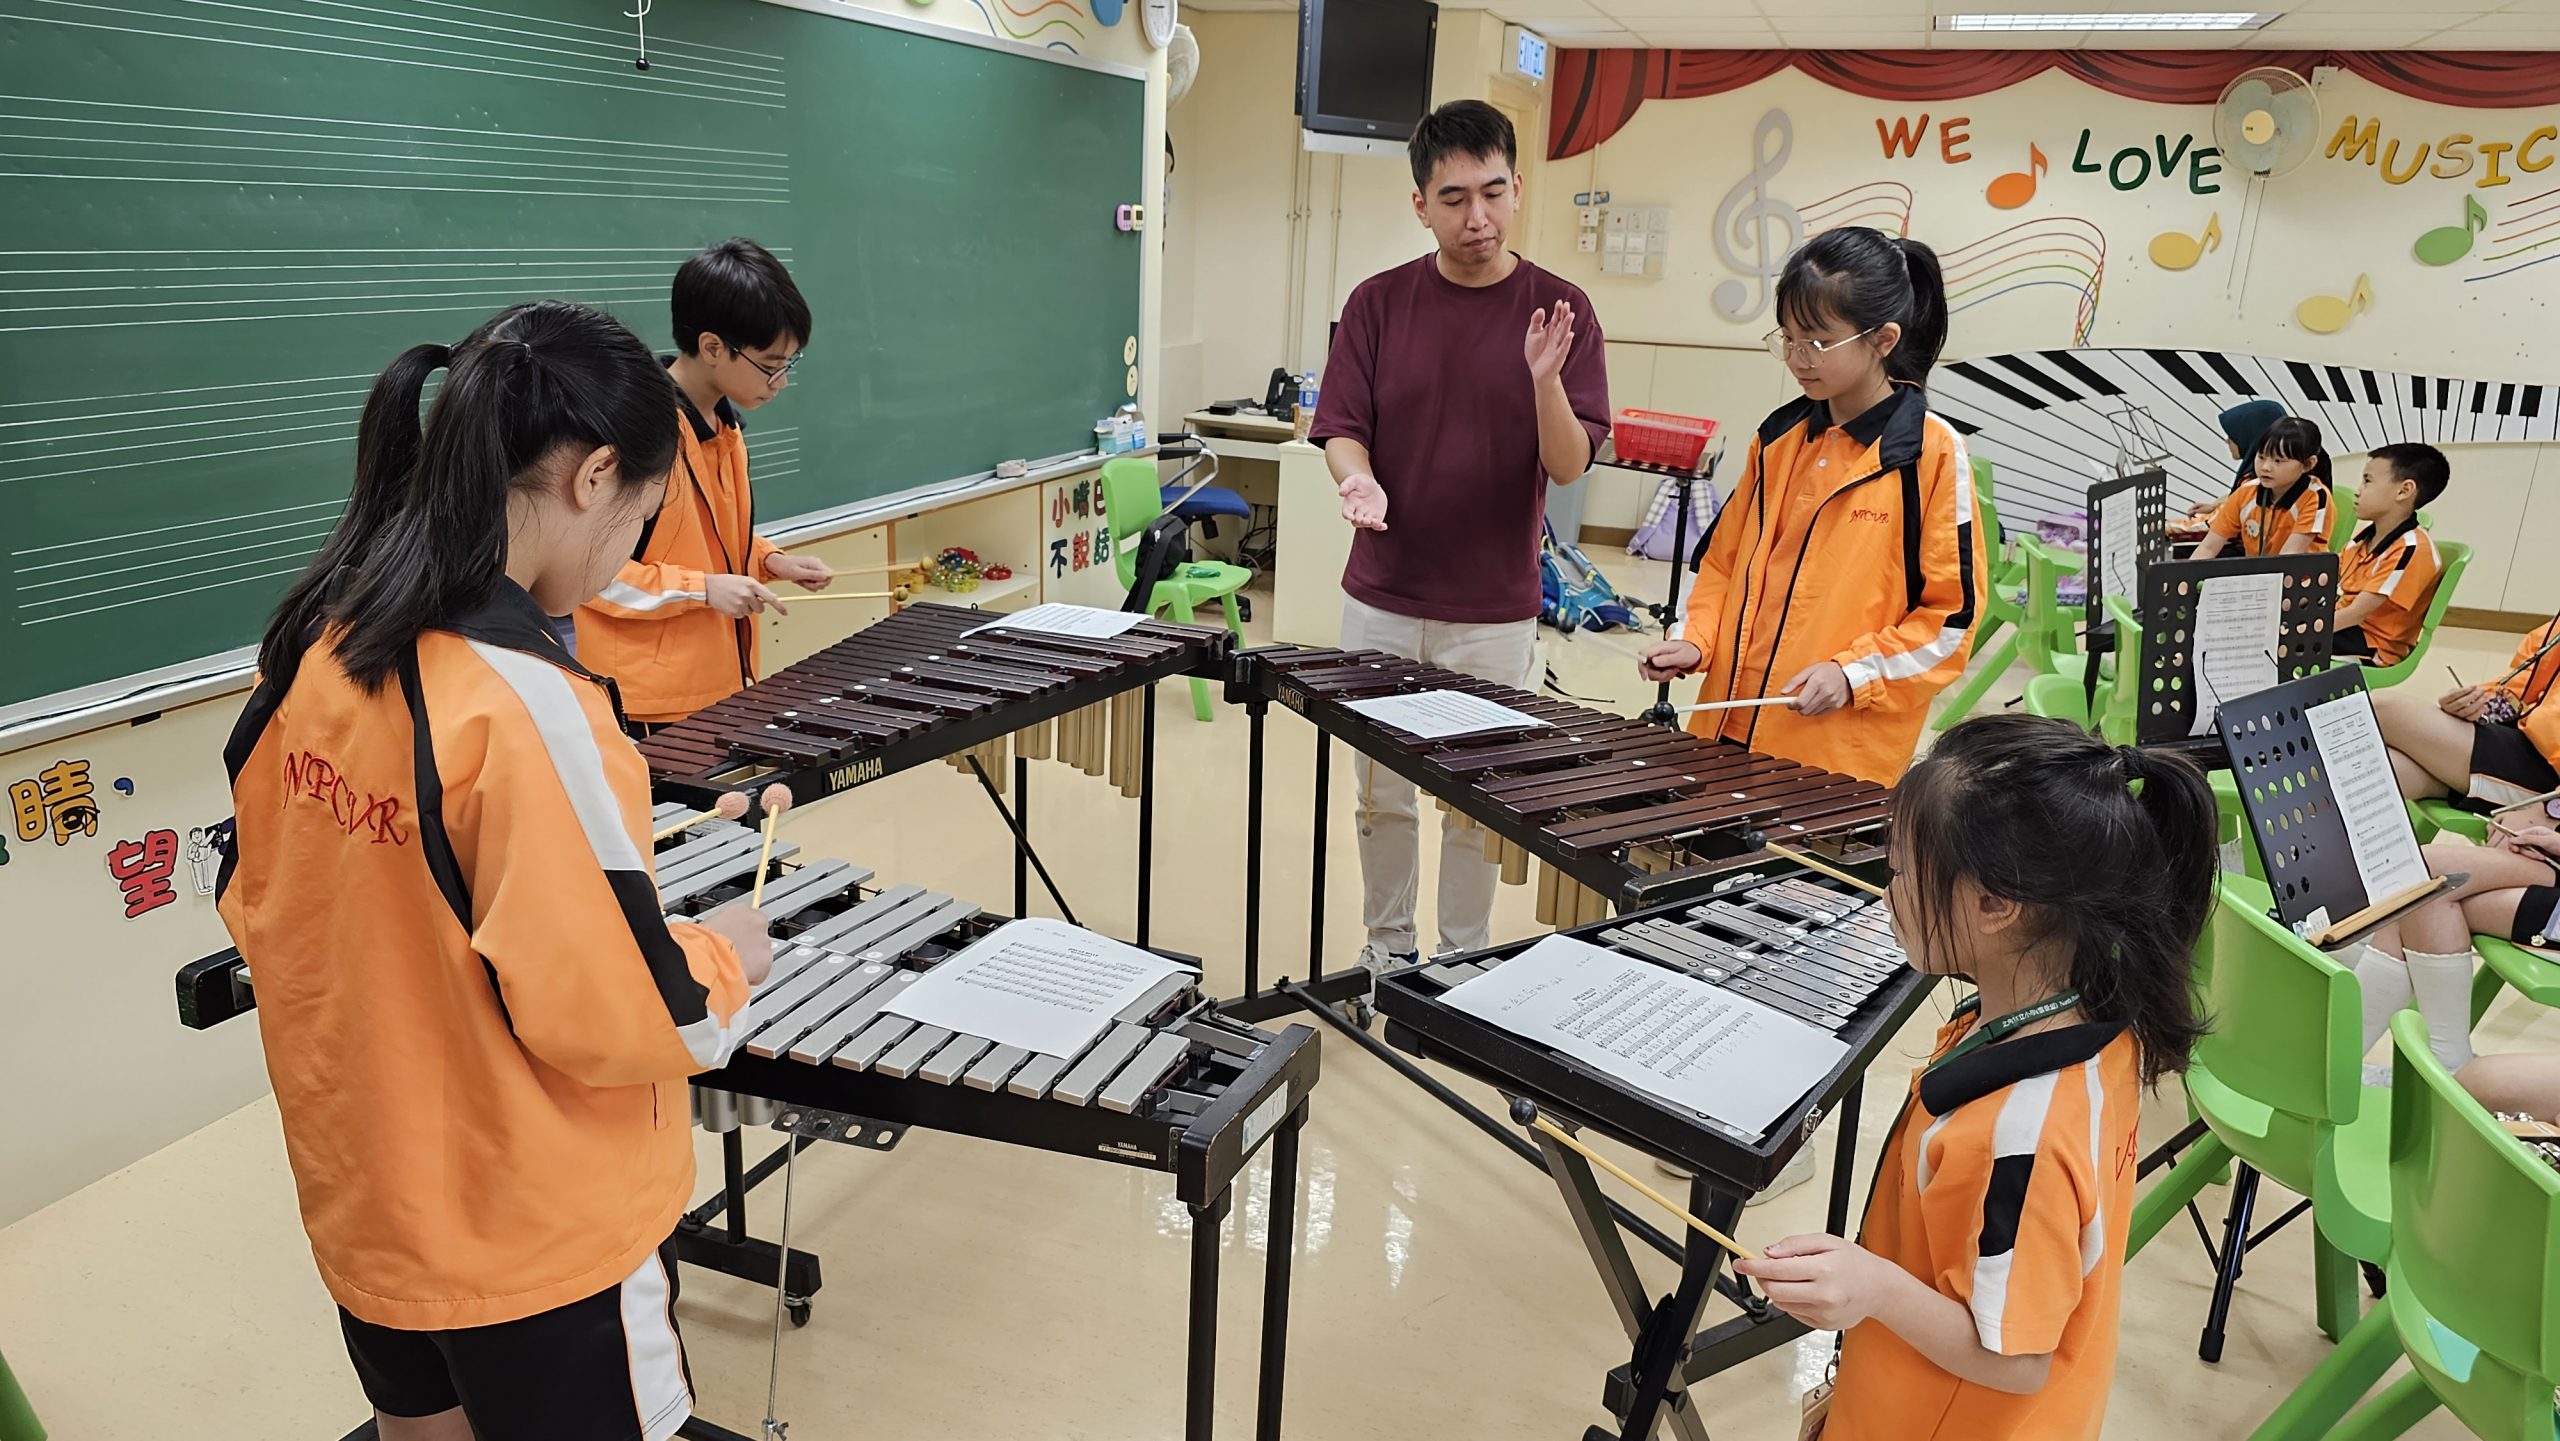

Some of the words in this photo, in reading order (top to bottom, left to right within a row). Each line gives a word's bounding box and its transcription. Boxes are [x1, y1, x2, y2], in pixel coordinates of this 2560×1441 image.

[1876, 113, 1972, 164] WE
[2072, 128, 2224, 195] LOVE
[2325, 115, 2558, 188] MUSIC
[1277, 683, 1304, 715] YAMAHA
[283, 751, 409, 847] NPCVR
[829, 756, 883, 791] YAMAHA
[108, 830, 177, 918] 望
